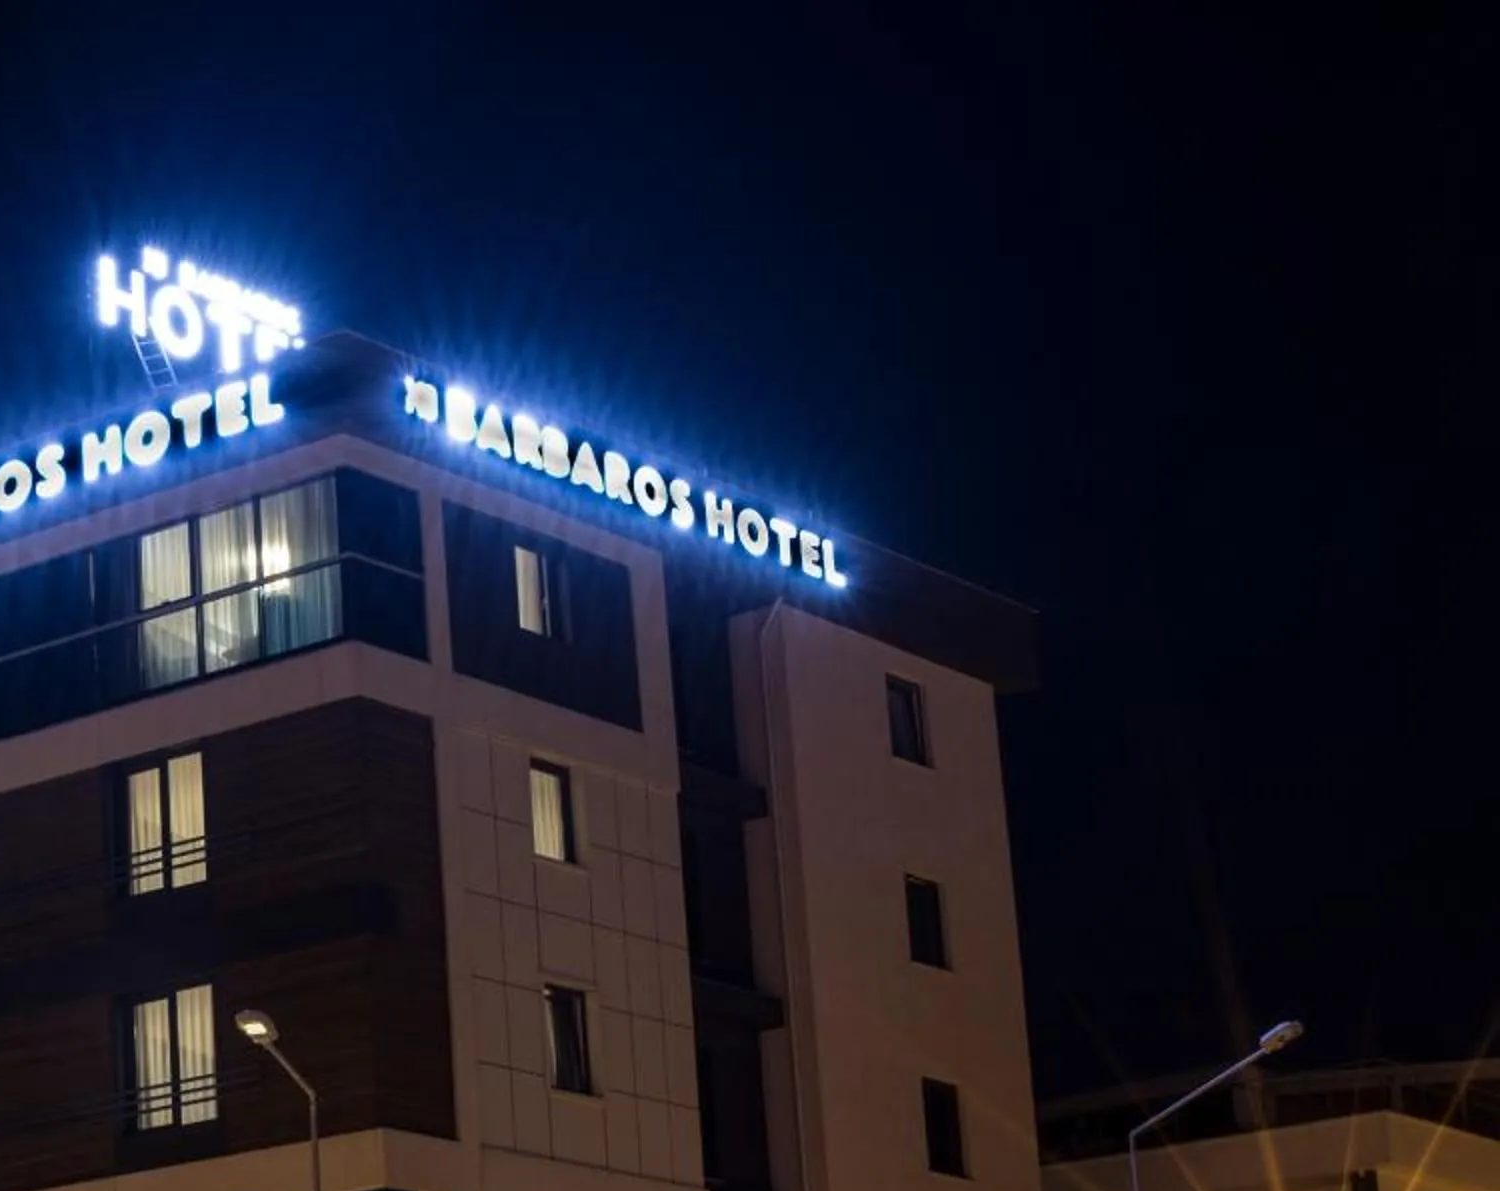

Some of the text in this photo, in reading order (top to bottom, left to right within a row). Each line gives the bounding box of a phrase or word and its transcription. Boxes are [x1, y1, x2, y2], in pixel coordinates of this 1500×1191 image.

[82, 371, 285, 484] HOTEL
[444, 383, 847, 588] BARBAROS HOTEL
